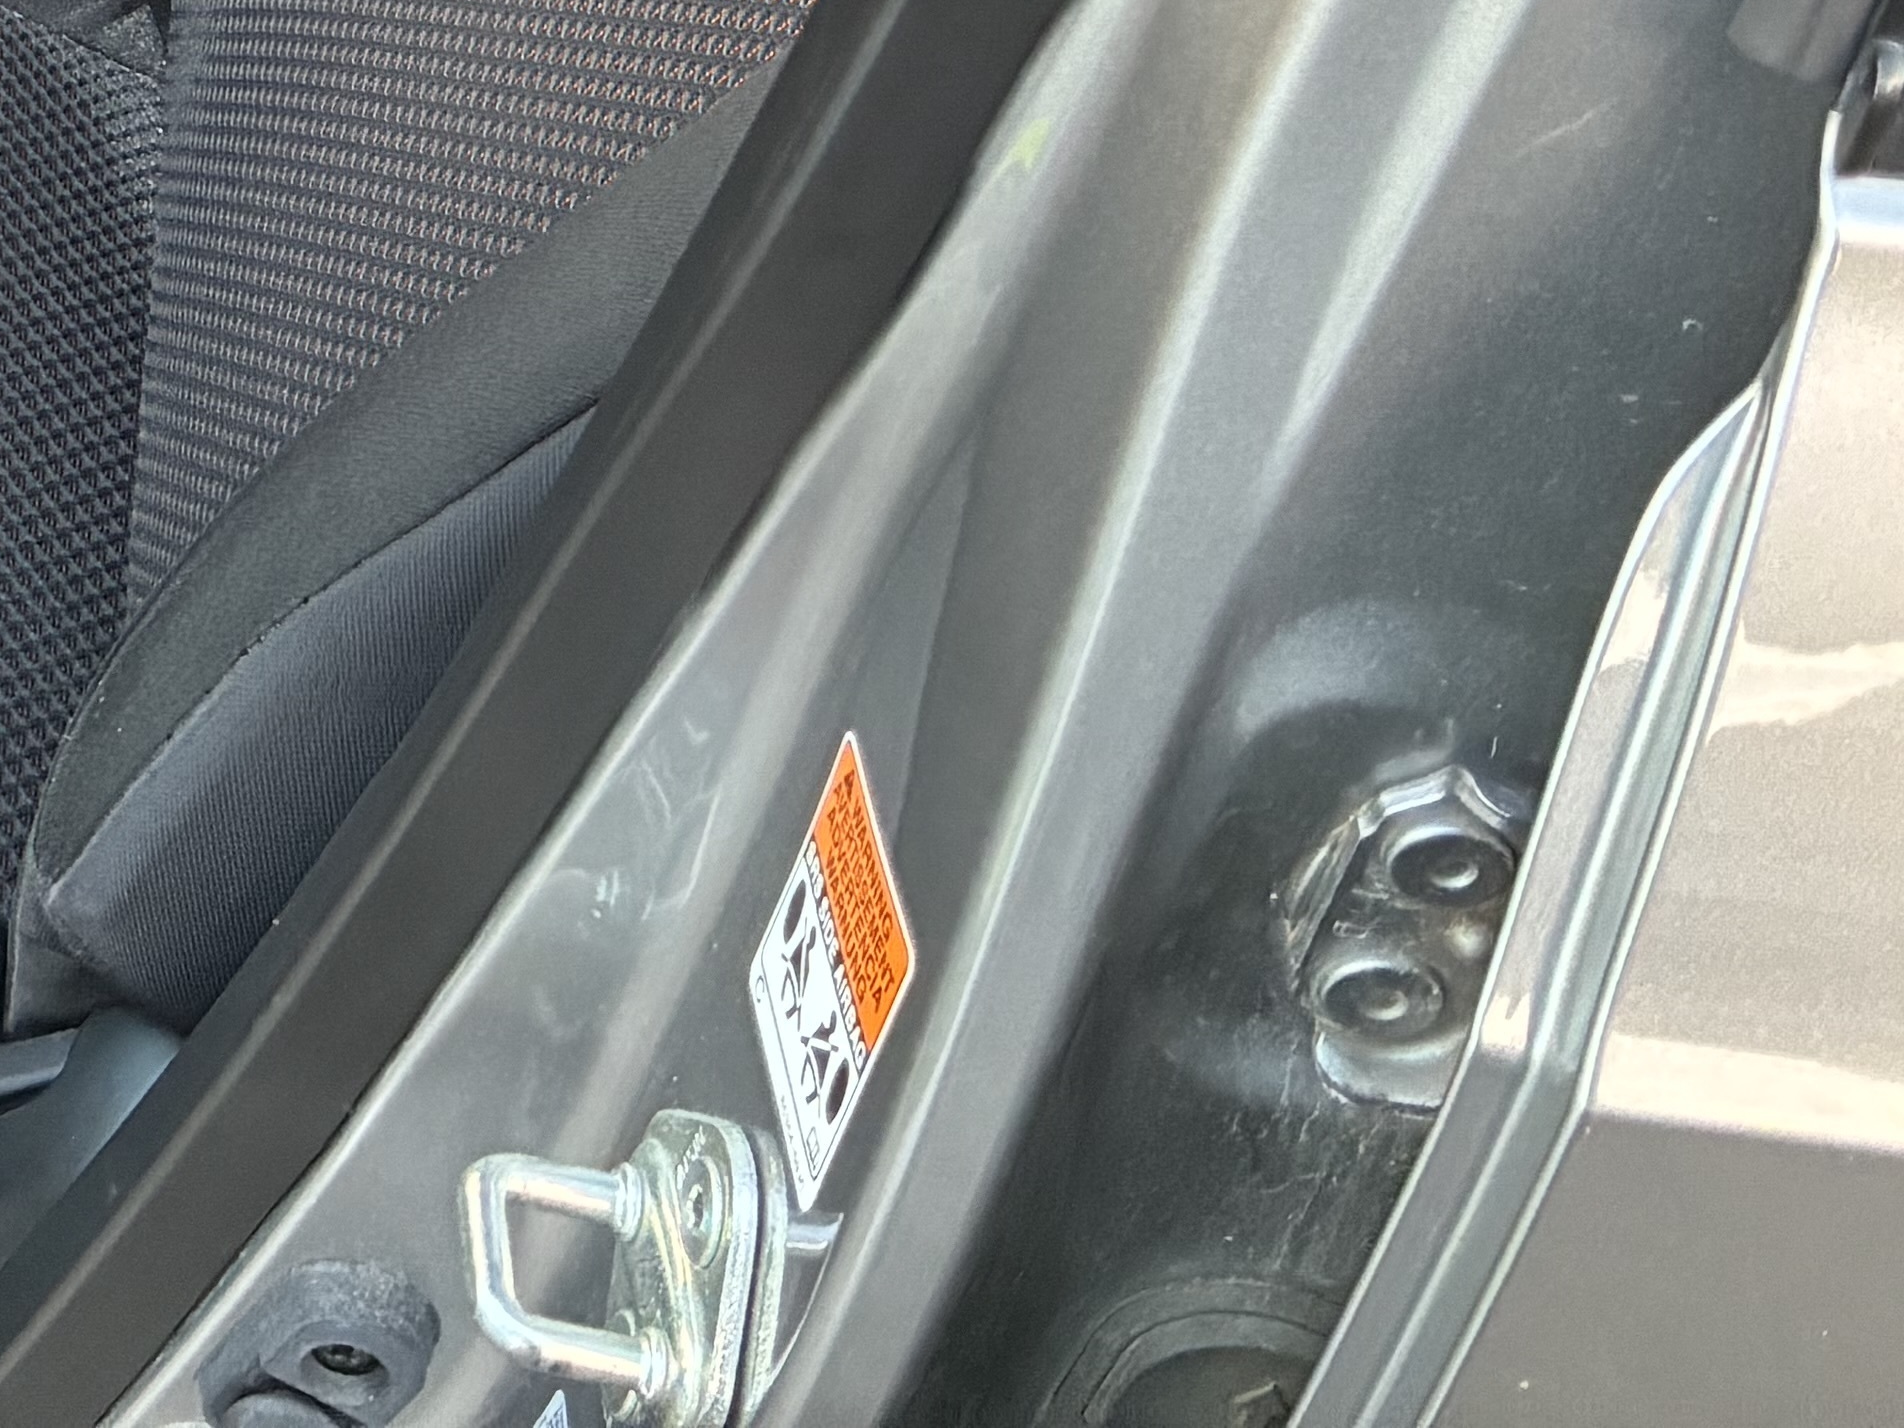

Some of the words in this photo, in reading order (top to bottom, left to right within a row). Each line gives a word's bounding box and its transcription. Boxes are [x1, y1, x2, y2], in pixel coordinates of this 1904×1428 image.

[805, 841, 825, 900] SRS
[818, 896, 840, 966] SIDE
[833, 963, 867, 1072] AIRBAG
[826, 806, 882, 1014] ADVERTENCIA
[826, 850, 867, 1005] WARNUNG
[833, 781, 895, 993] AVERTISSEMENT
[852, 797, 894, 944] WARNING
